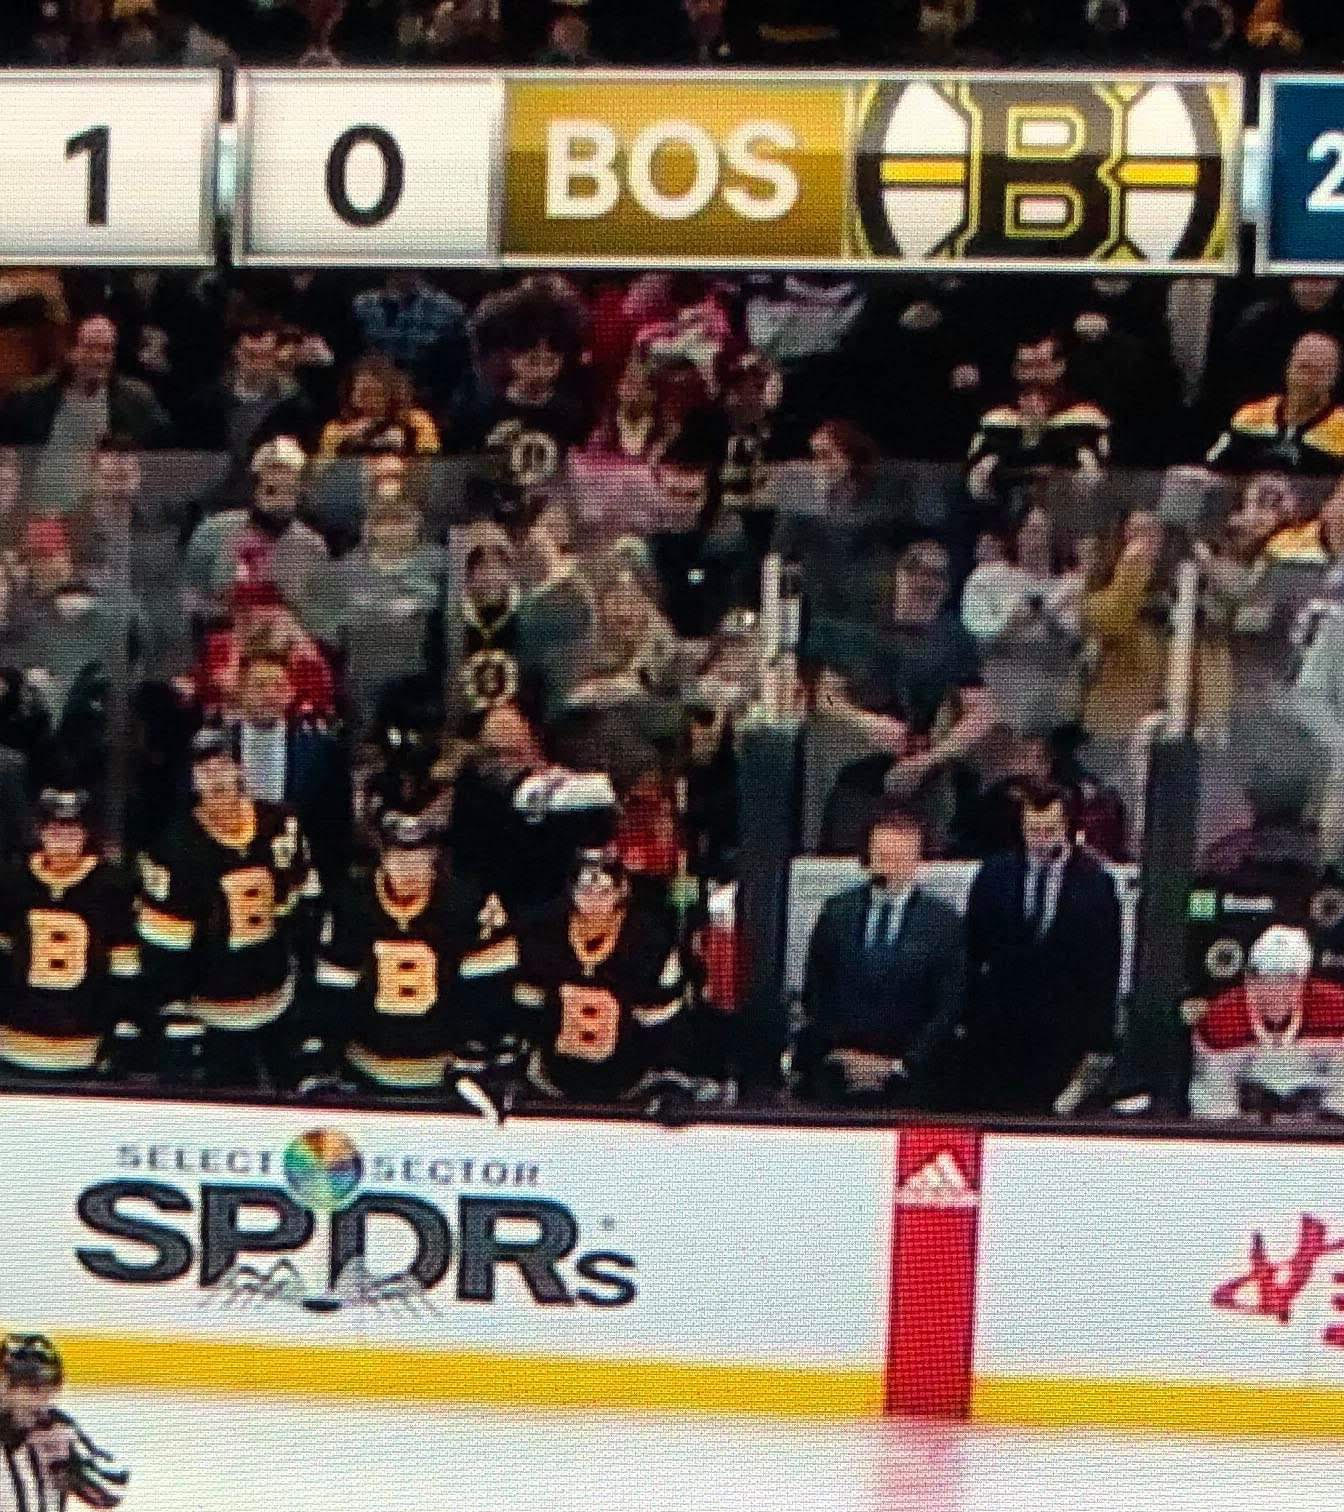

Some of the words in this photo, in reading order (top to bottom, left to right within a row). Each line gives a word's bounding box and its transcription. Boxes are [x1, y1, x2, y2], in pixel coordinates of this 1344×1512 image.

[61, 122, 113, 227] 1
[325, 122, 406, 228] 0
[543, 117, 801, 221] BOS
[220, 866, 276, 949] B
[26, 908, 88, 991] B
[372, 939, 438, 1016] B
[556, 984, 620, 1063] B
[117, 1144, 272, 1174] SELECT
[371, 1156, 542, 1186] SECTOR
